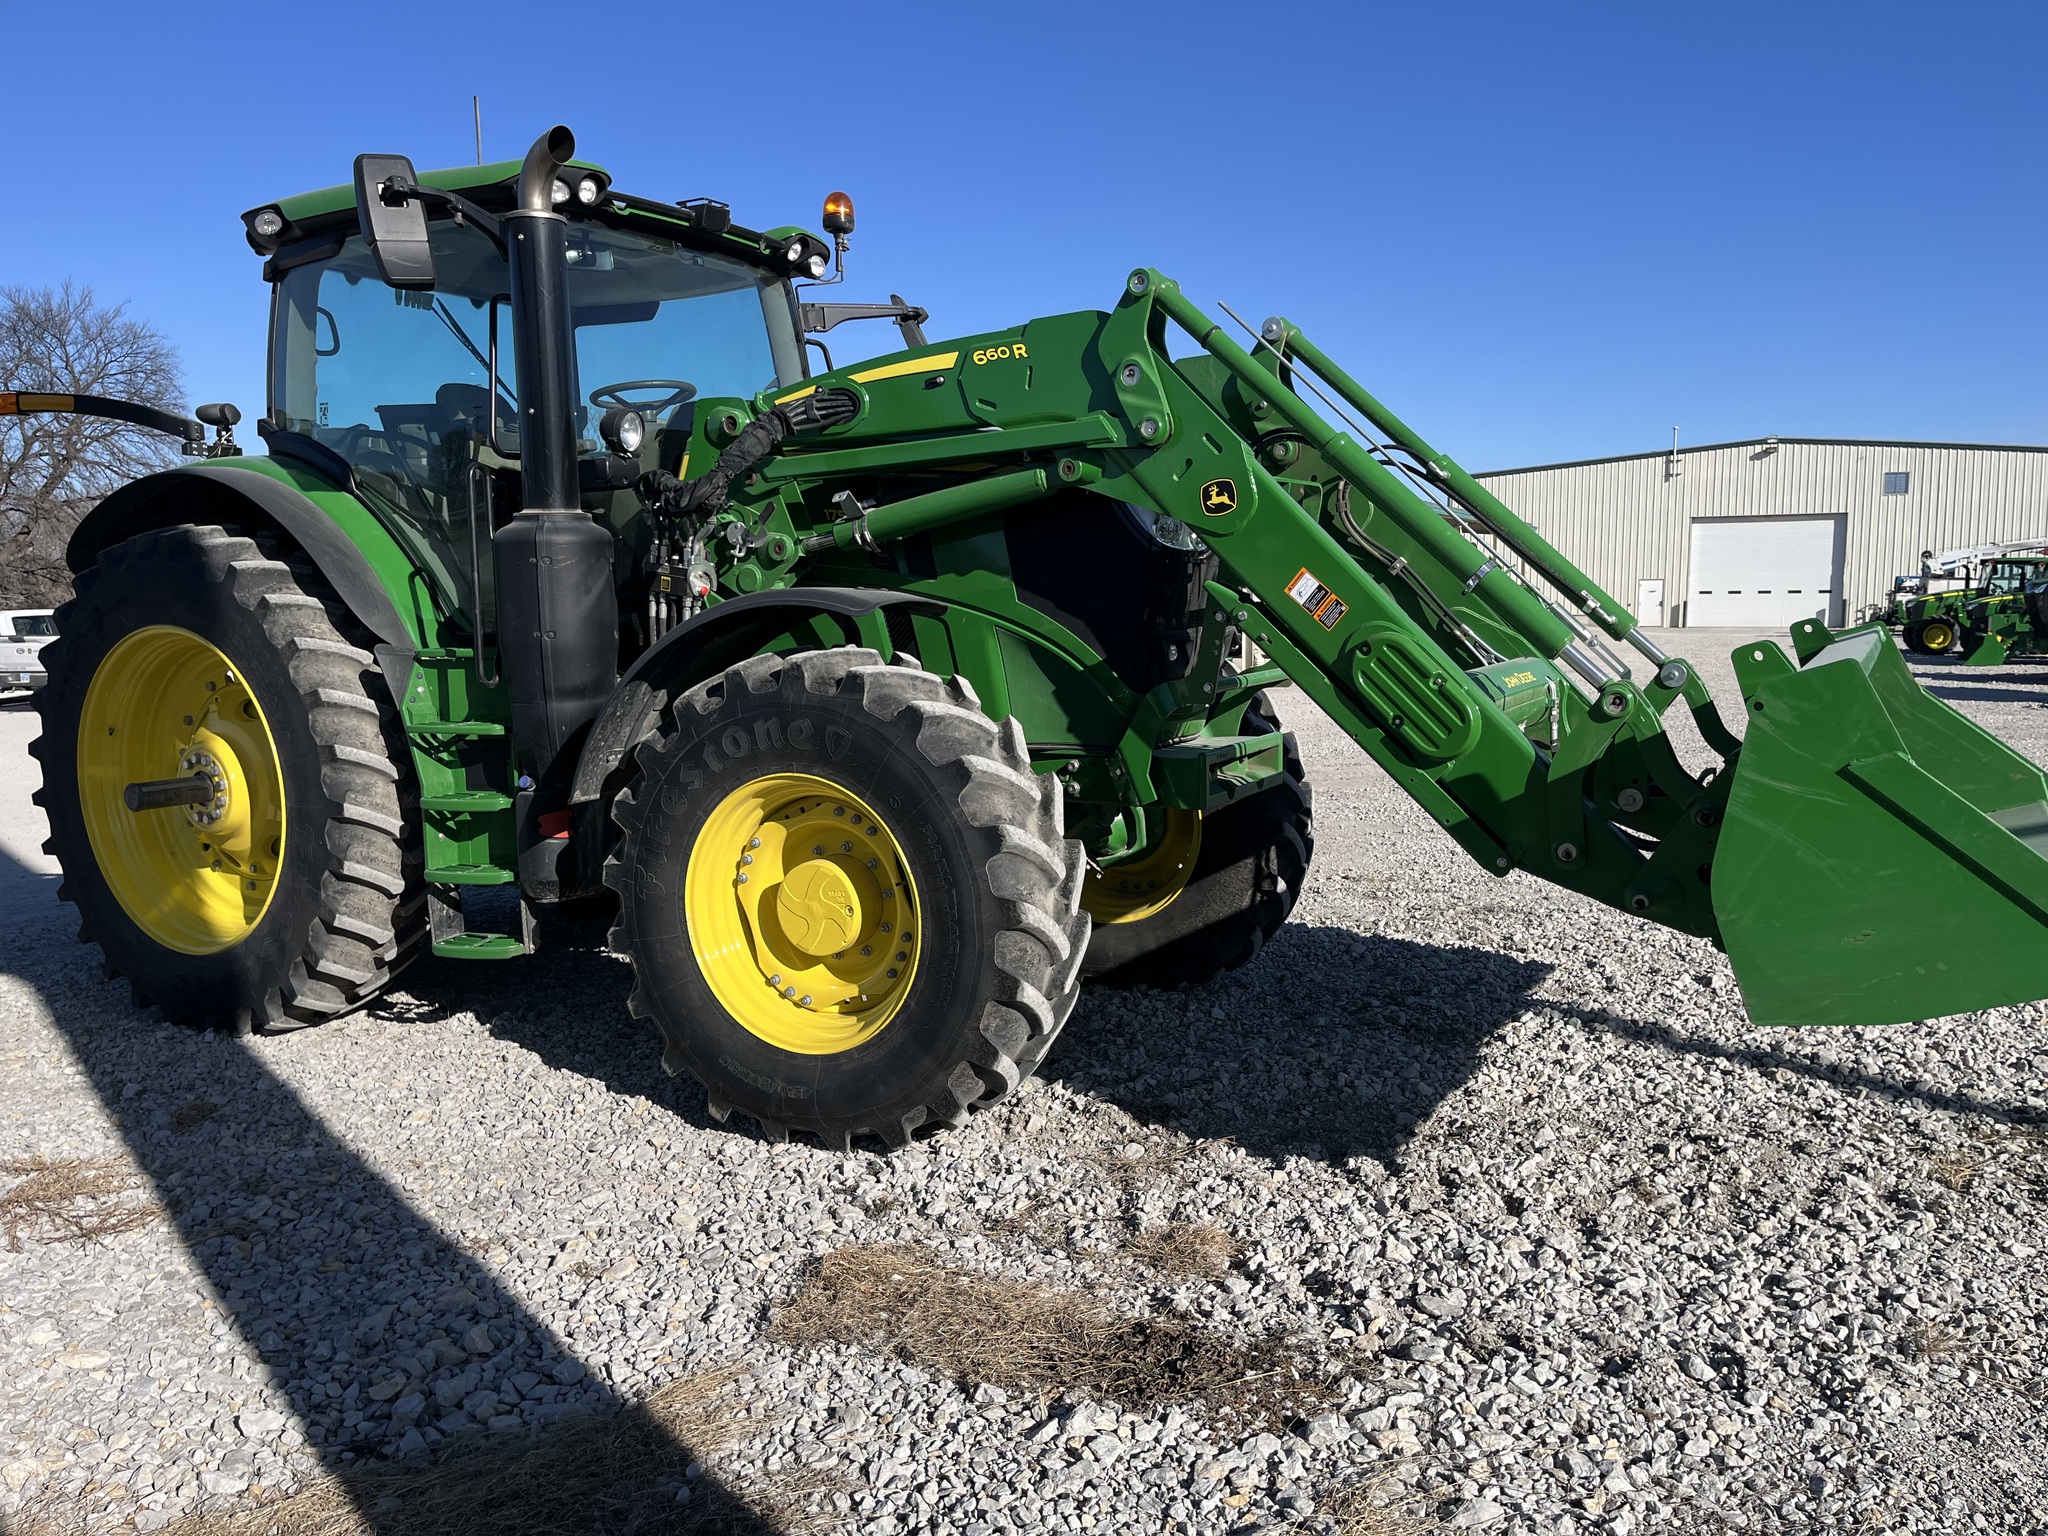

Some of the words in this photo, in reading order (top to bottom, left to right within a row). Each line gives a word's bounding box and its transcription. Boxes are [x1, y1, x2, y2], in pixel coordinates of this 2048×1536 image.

[973, 346, 1011, 366] 660
[1012, 343, 1029, 359] R
[636, 716, 815, 900] Firestone
